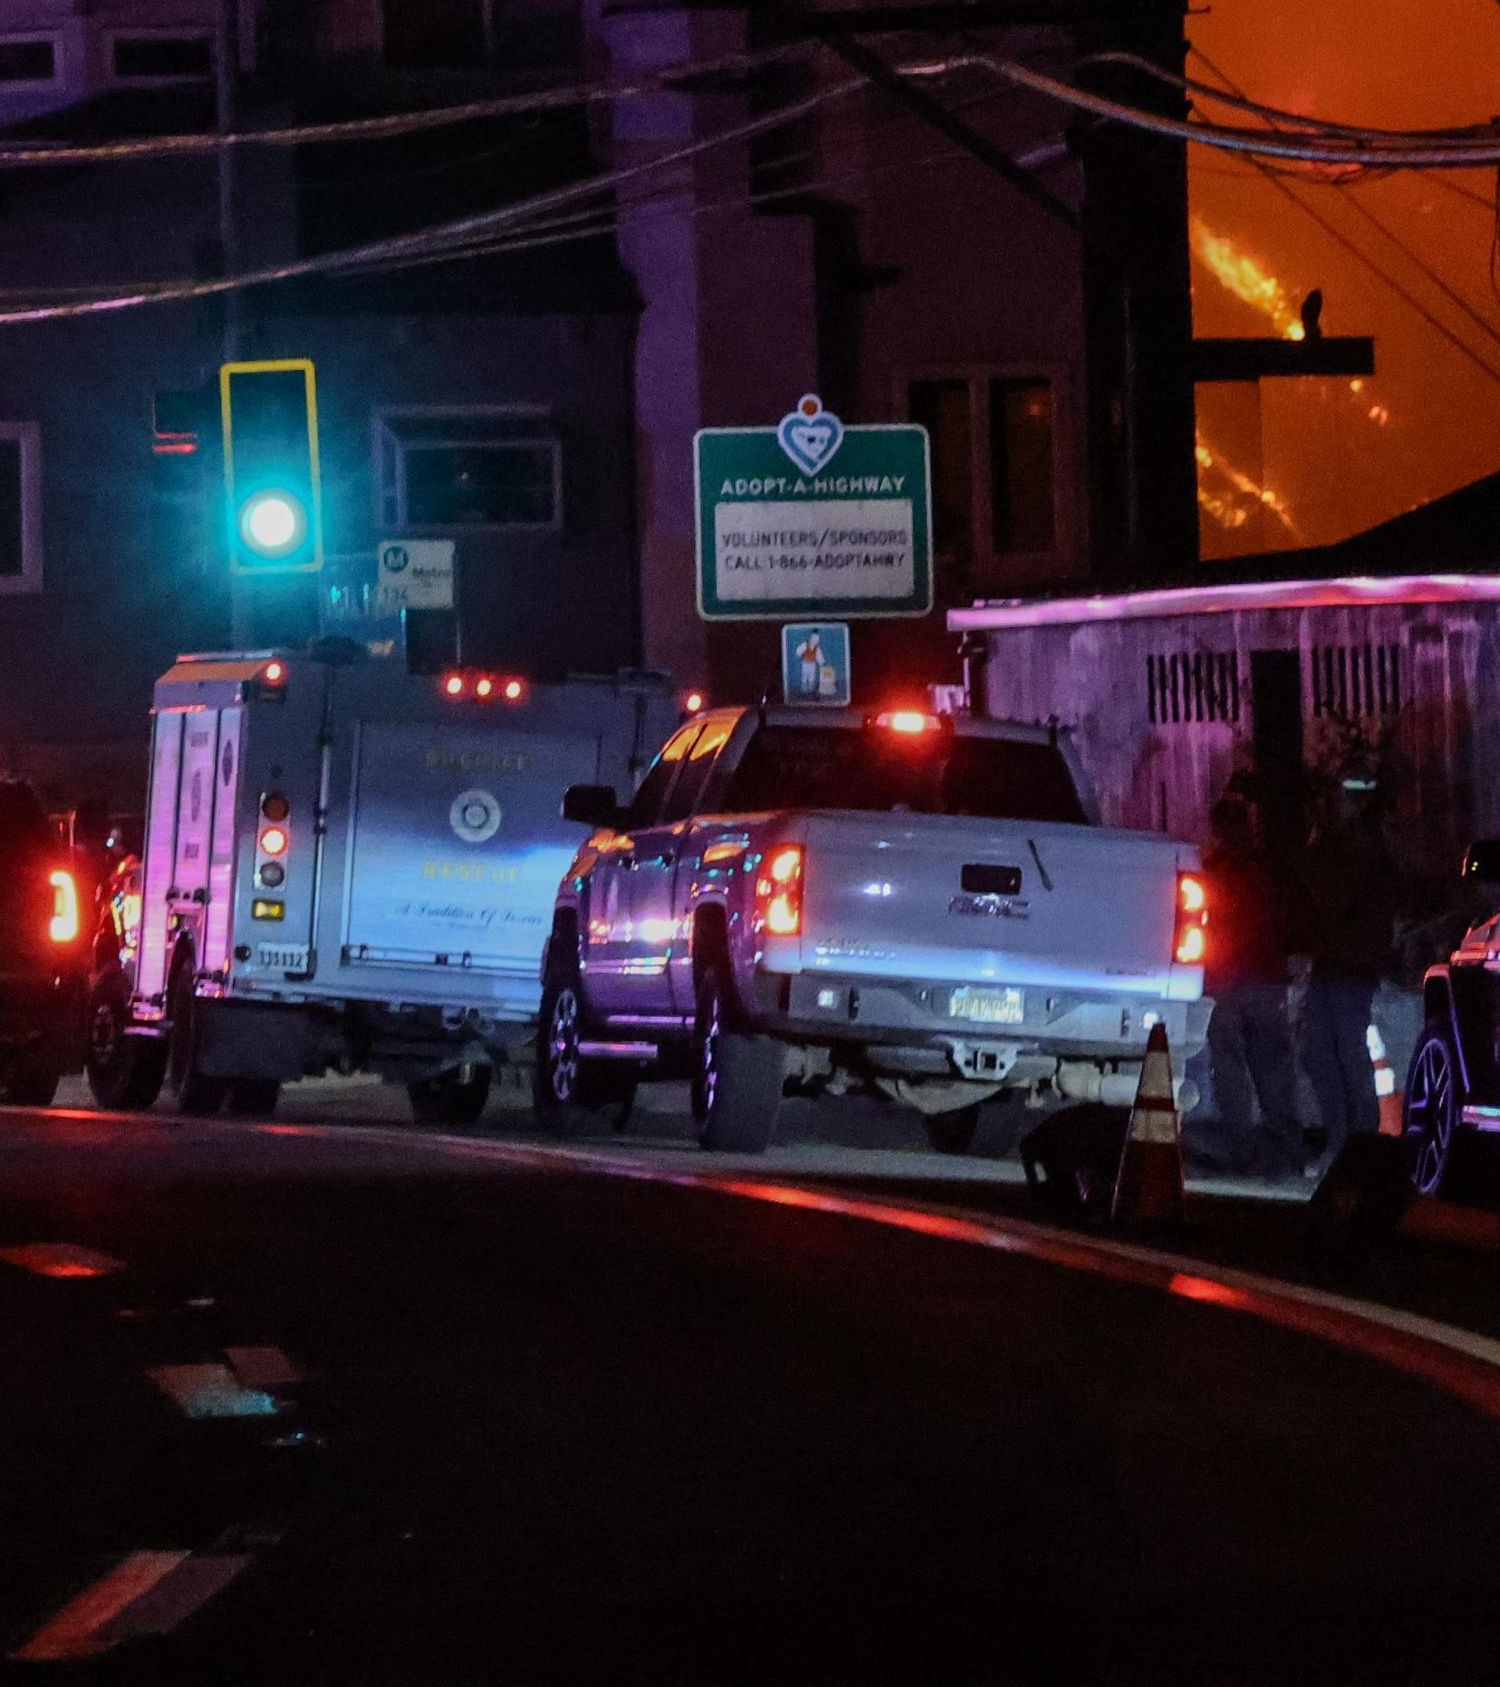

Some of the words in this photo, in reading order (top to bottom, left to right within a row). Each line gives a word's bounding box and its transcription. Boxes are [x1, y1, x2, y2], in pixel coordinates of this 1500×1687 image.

[721, 475, 905, 496] ADOPT-A-HIGHWAY
[722, 529, 908, 551] VOLUNTEERS/SPONSORS
[725, 555, 763, 570] CALL
